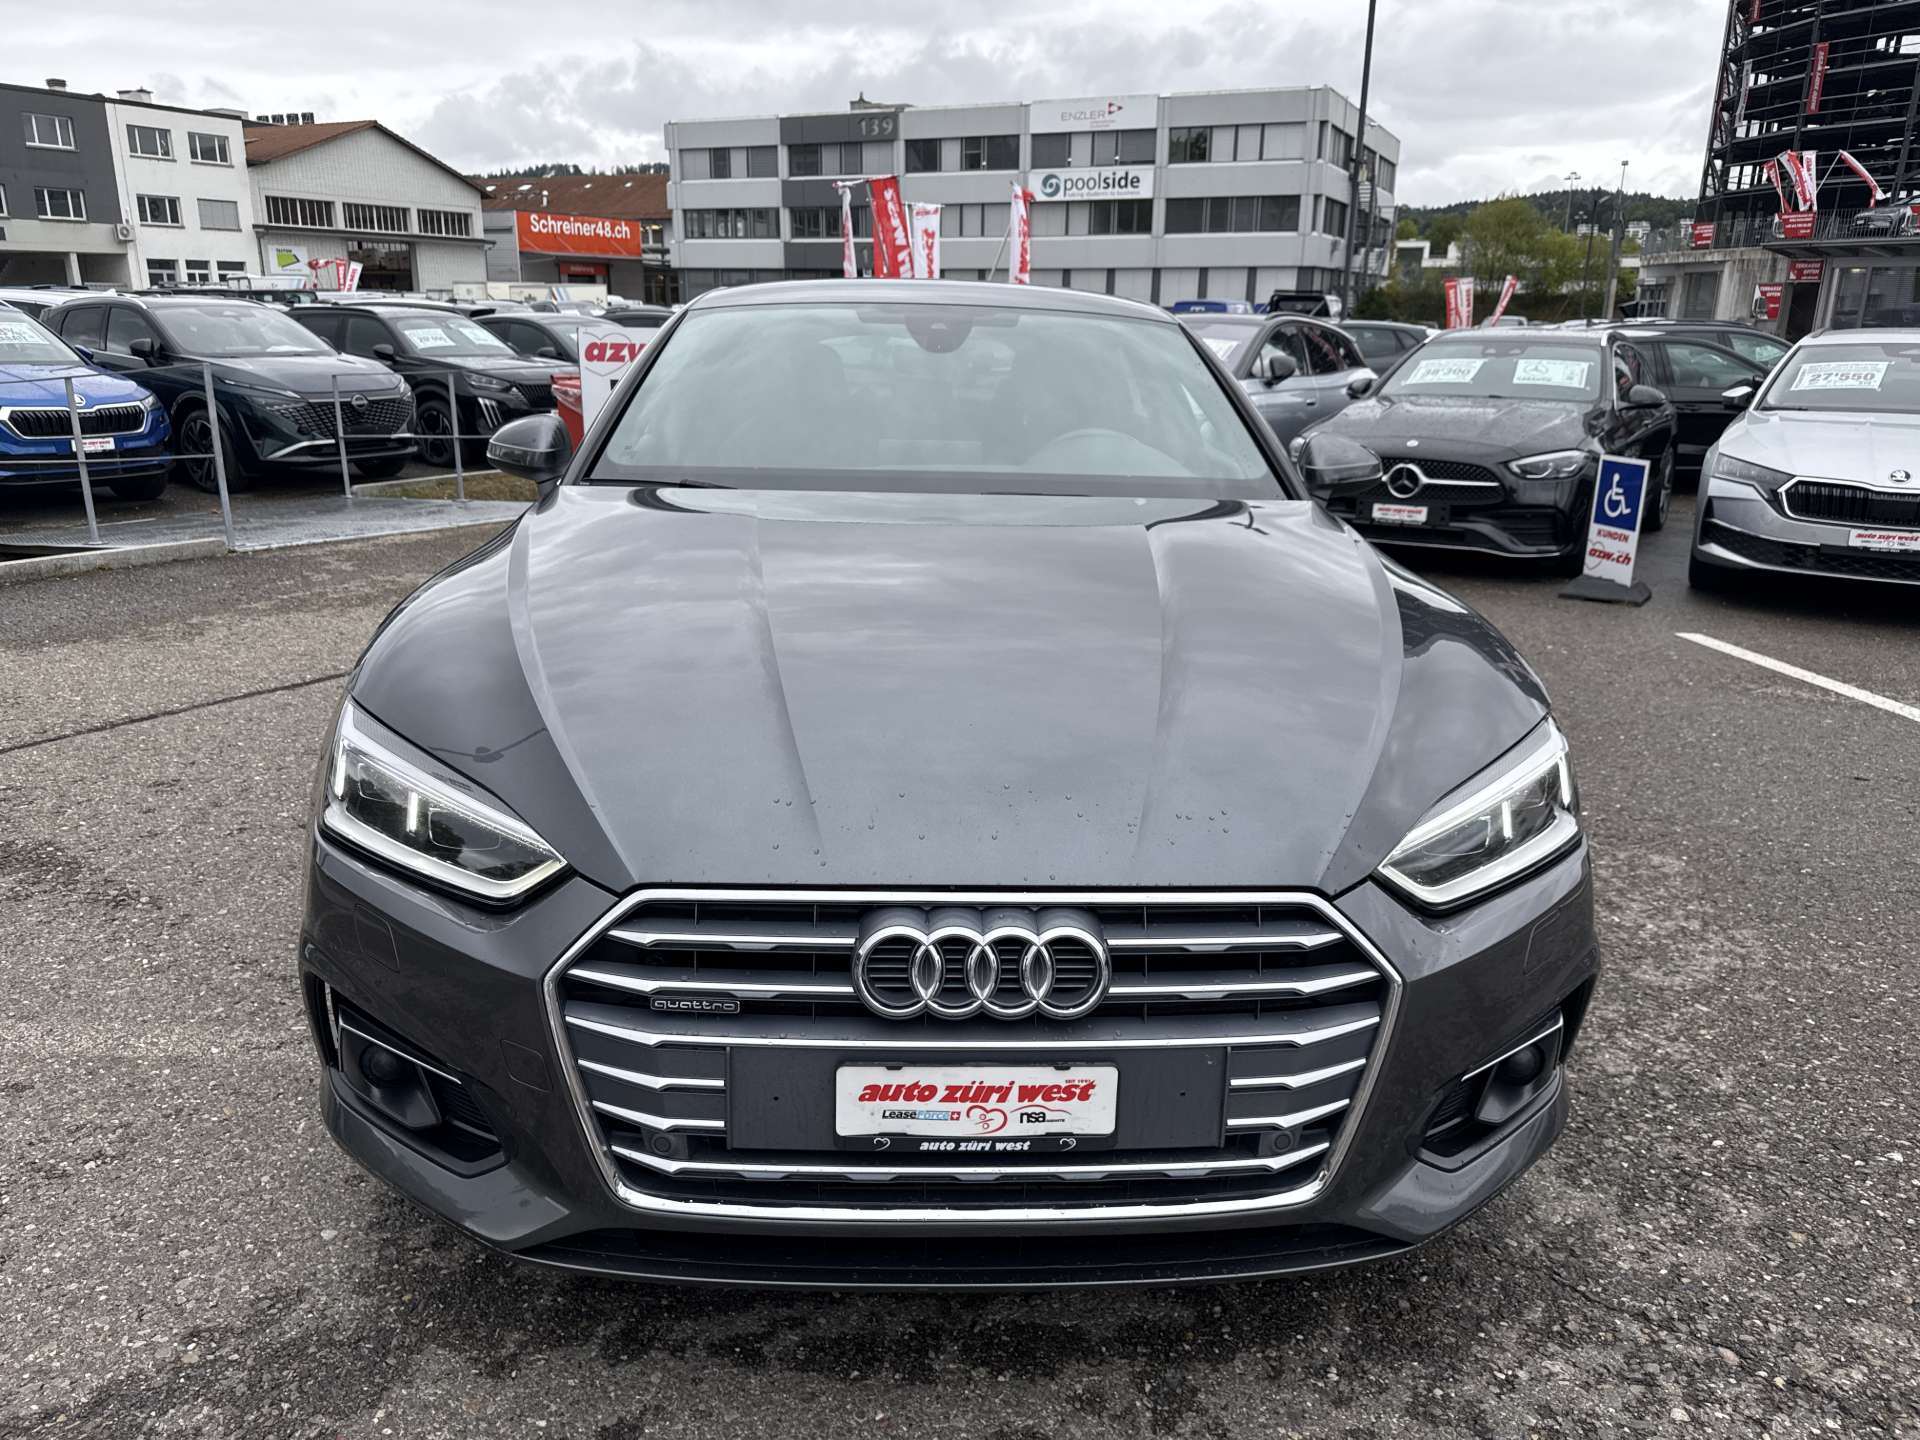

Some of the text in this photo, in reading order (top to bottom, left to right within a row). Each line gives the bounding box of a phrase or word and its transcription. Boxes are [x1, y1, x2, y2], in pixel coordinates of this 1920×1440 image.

[1061, 110, 1106, 121] ENZLER
[860, 118, 894, 136] 139
[1063, 170, 1140, 198] poolside
[530, 213, 631, 240] Schreiner48.ch
[1809, 372, 1876, 382] 27'550
[1597, 529, 1630, 543] KUNDEN
[1588, 548, 1632, 565] azw.ch
[654, 1000, 735, 1011] quattro
[858, 1080, 1097, 1103] auto züri west
[882, 1109, 949, 1120] LeaseForce
[1019, 1112, 1046, 1124] nsa
[920, 1140, 1031, 1151] auto züri west
